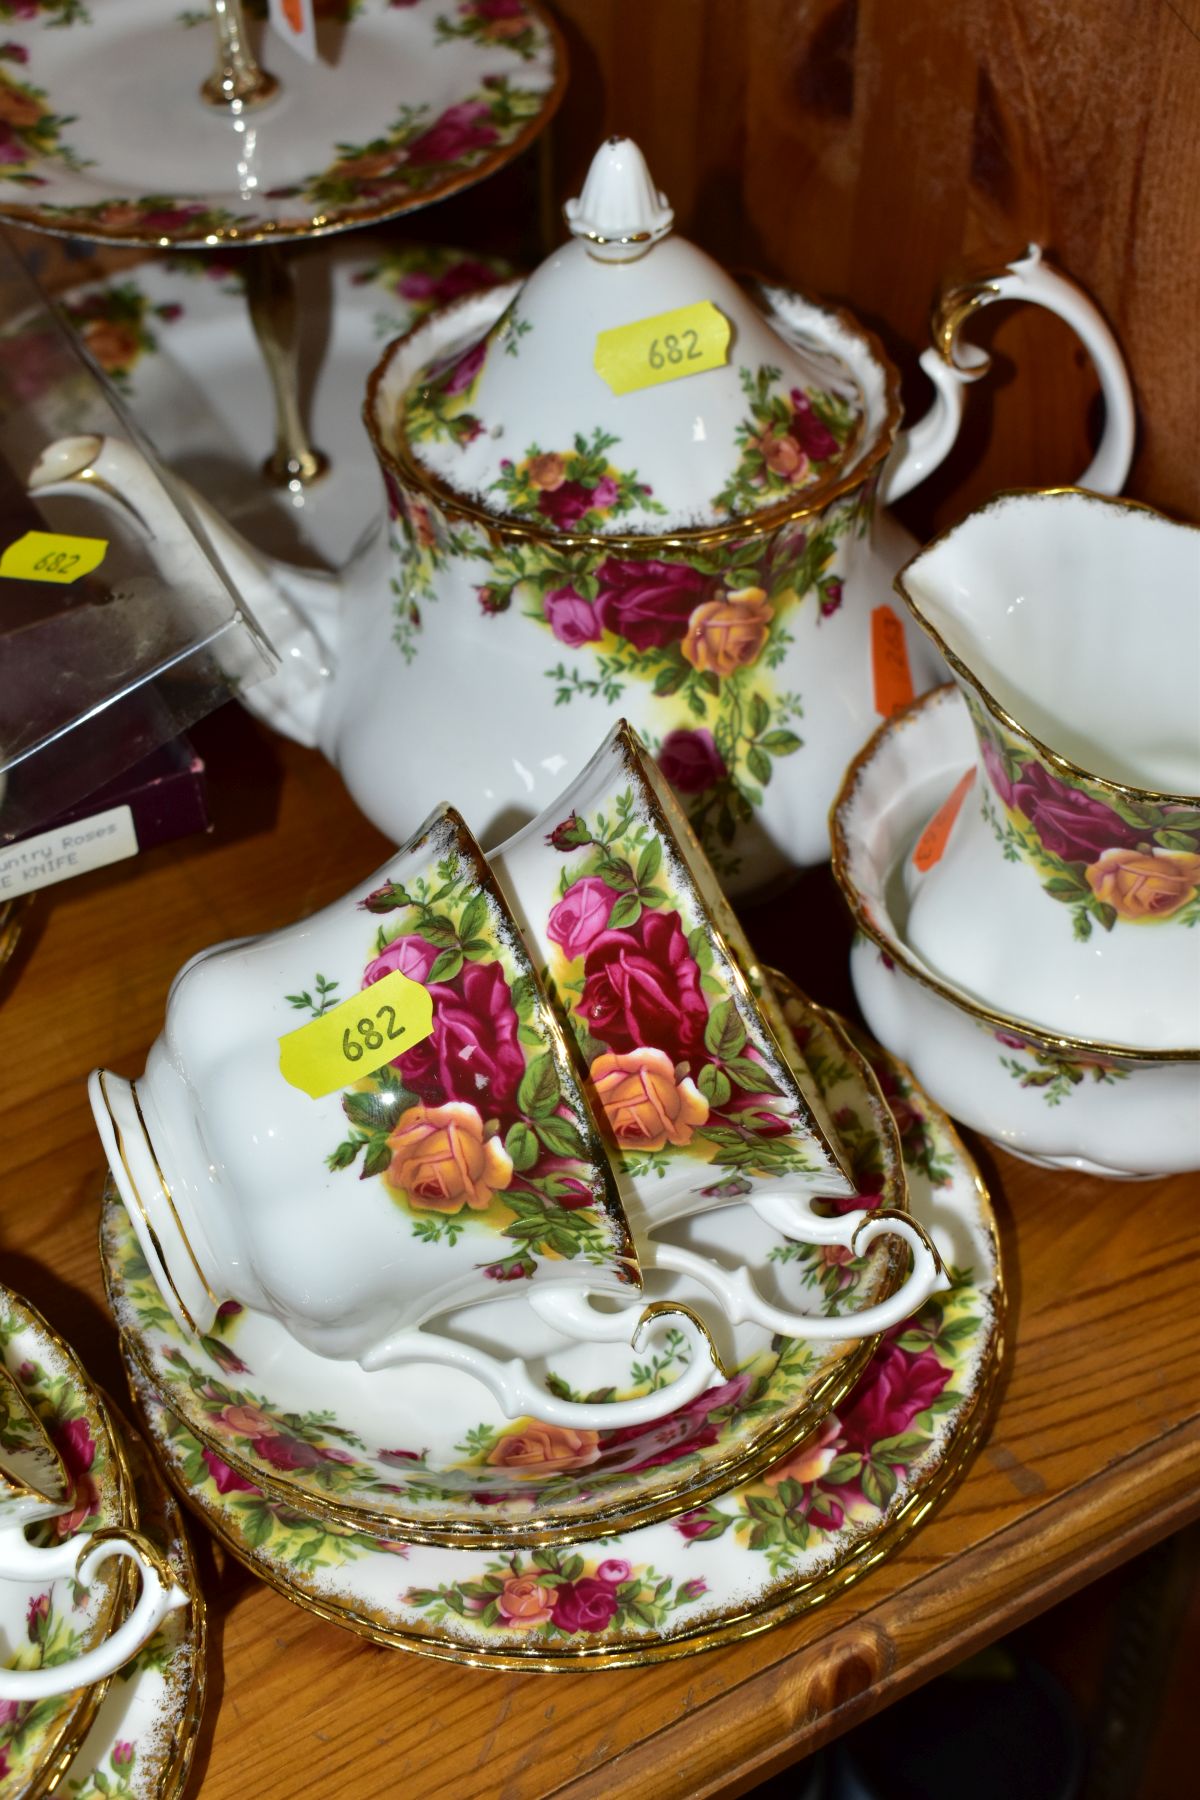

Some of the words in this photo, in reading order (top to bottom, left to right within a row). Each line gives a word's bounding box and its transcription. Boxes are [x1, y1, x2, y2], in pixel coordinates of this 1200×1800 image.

[649, 329, 703, 370] 682
[33, 552, 80, 574] 682
[62, 823, 117, 849] Roses
[22, 852, 79, 880] KNIFE
[342, 1005, 406, 1062] 682
